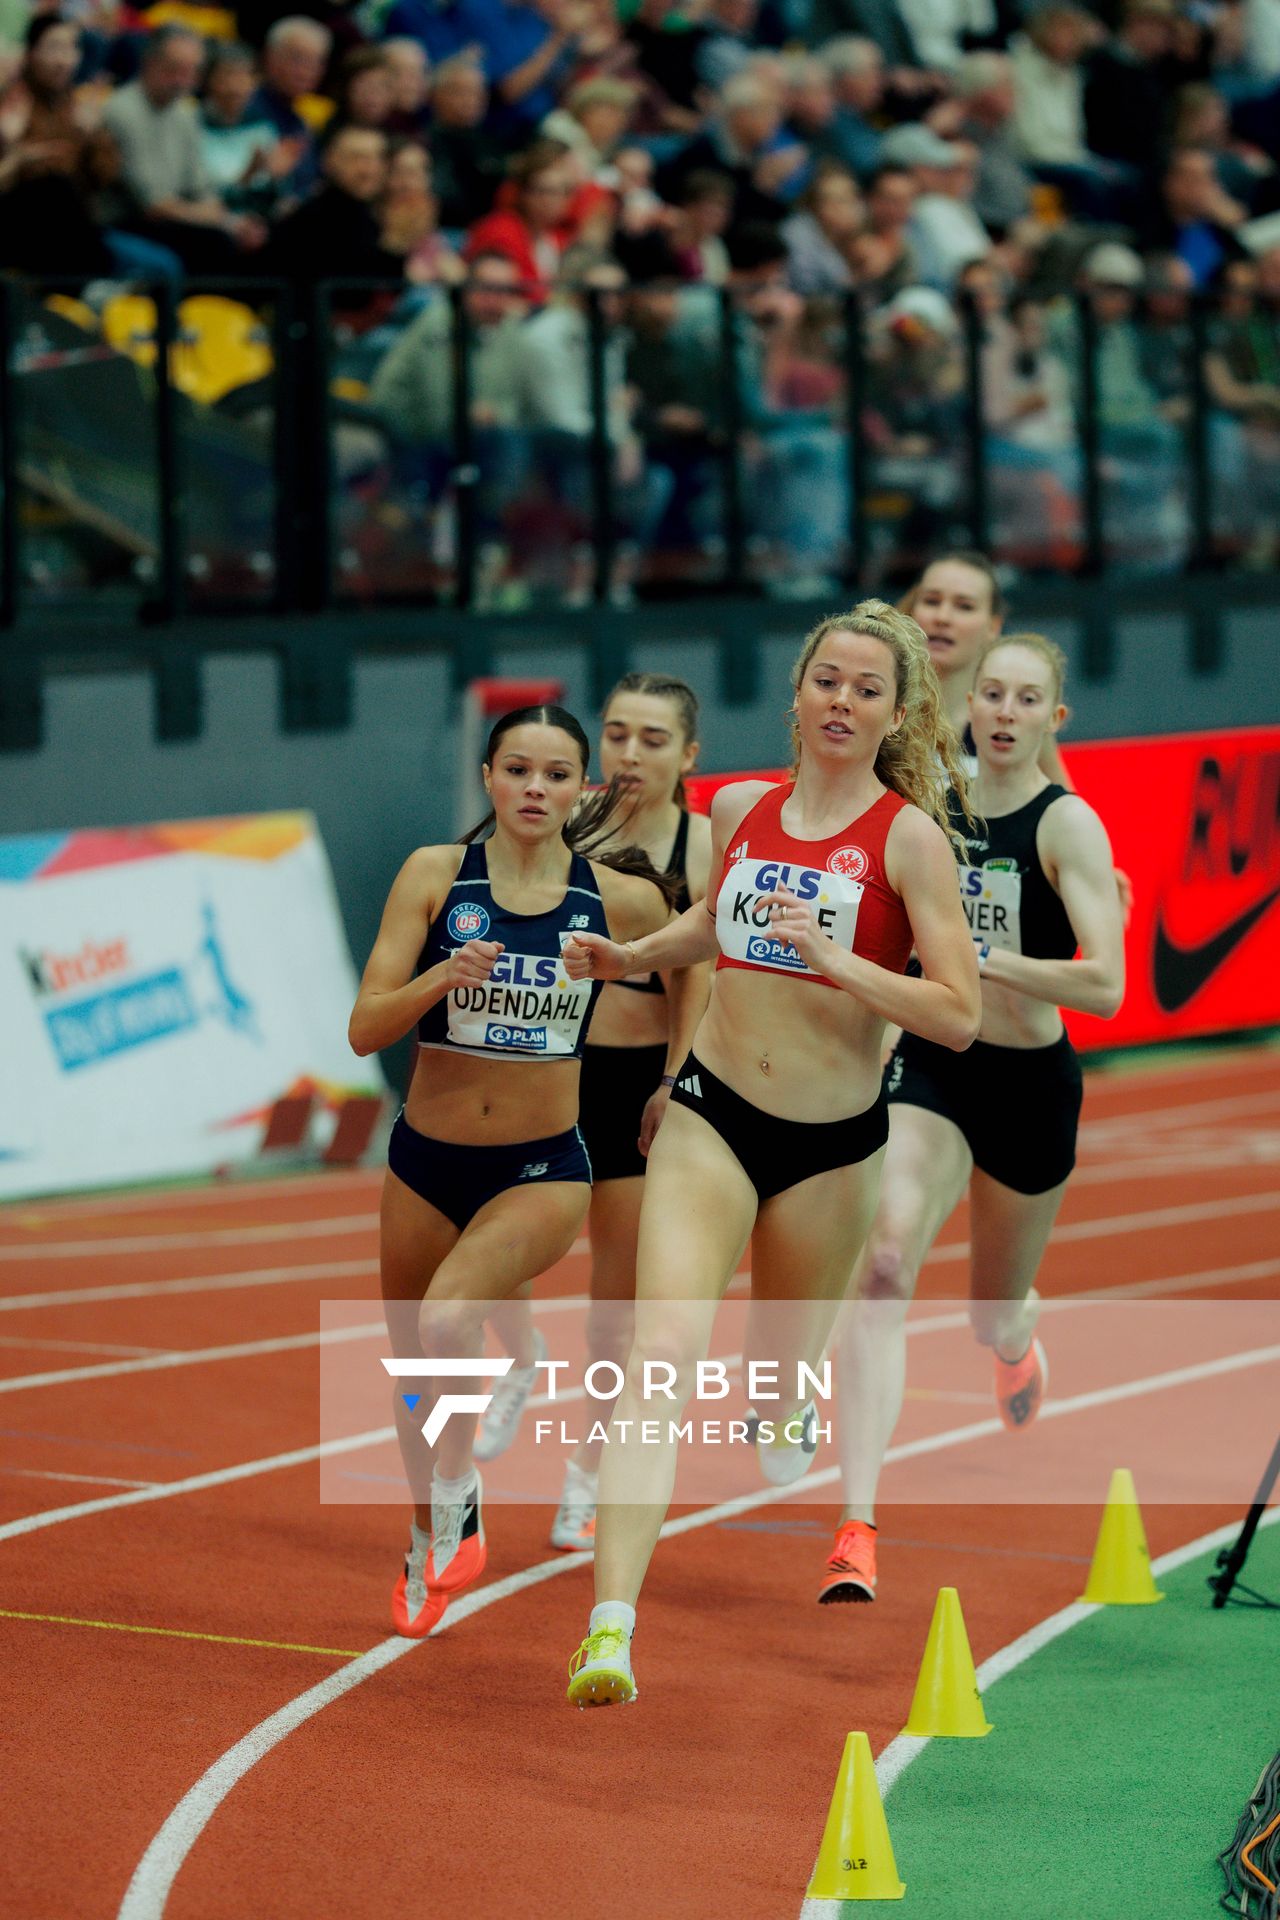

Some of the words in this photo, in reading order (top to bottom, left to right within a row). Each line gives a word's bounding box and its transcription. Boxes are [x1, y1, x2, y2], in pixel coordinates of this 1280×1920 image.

[453, 904, 487, 920] KREFELD
[732, 891, 837, 941] KOE
[459, 914, 478, 930] 05
[453, 986, 579, 1021] ODENDAHL
[512, 1030, 545, 1043] PLAN
